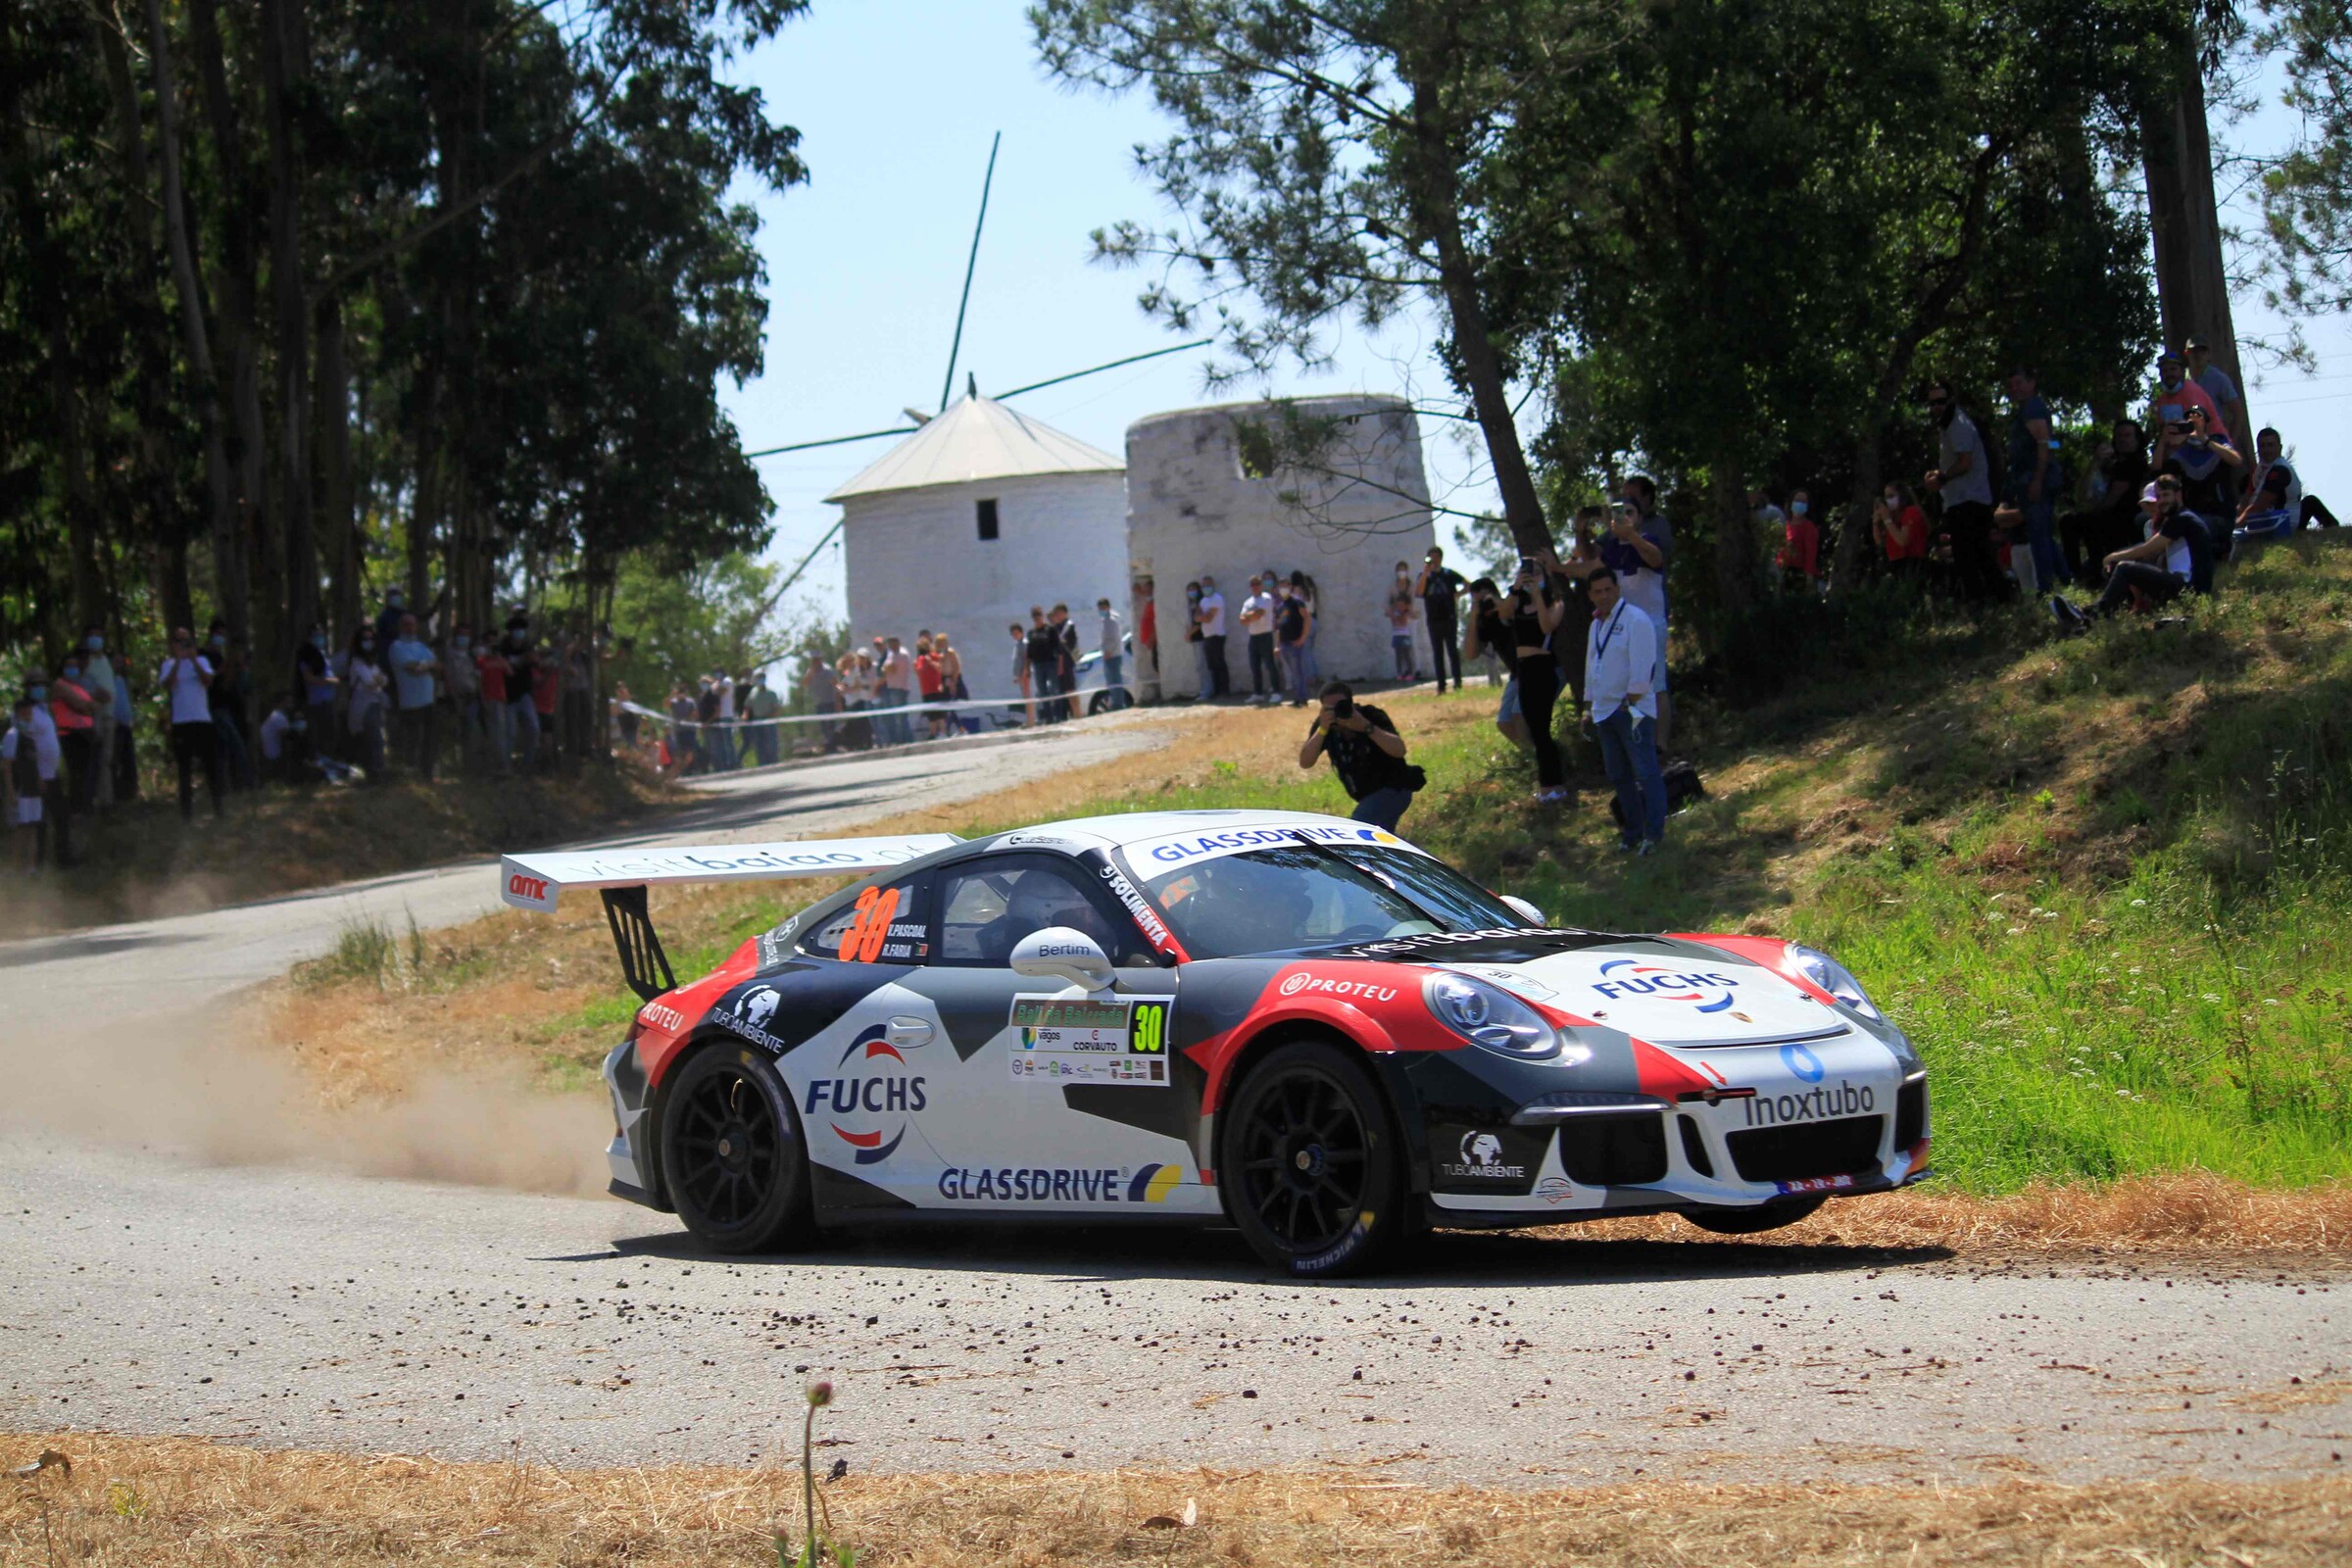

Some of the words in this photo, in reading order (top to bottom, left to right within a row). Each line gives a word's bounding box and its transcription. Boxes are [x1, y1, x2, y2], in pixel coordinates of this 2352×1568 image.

[1152, 827, 1356, 862] GLASSDRIVE
[838, 885, 901, 963] 30
[1108, 875, 1168, 947] SOLIMENTA
[882, 943, 911, 957] R.FARIA
[1039, 943, 1090, 957] Bertim
[1306, 978, 1397, 1003] PROTEU
[1488, 970, 1512, 979] 30
[1591, 973, 1740, 1000] FUCHS
[710, 1006, 785, 1054] TUBOAMBIENTE
[1133, 1004, 1163, 1052] 30
[1073, 1042, 1117, 1052] CORVAUTO
[805, 1076, 927, 1114] FUCHS
[938, 1168, 1119, 1200] GLASSDRIVE
[1442, 1163, 1525, 1177] TUBOAMBIENTE
[1297, 1236, 1355, 1270] MICHELIN
